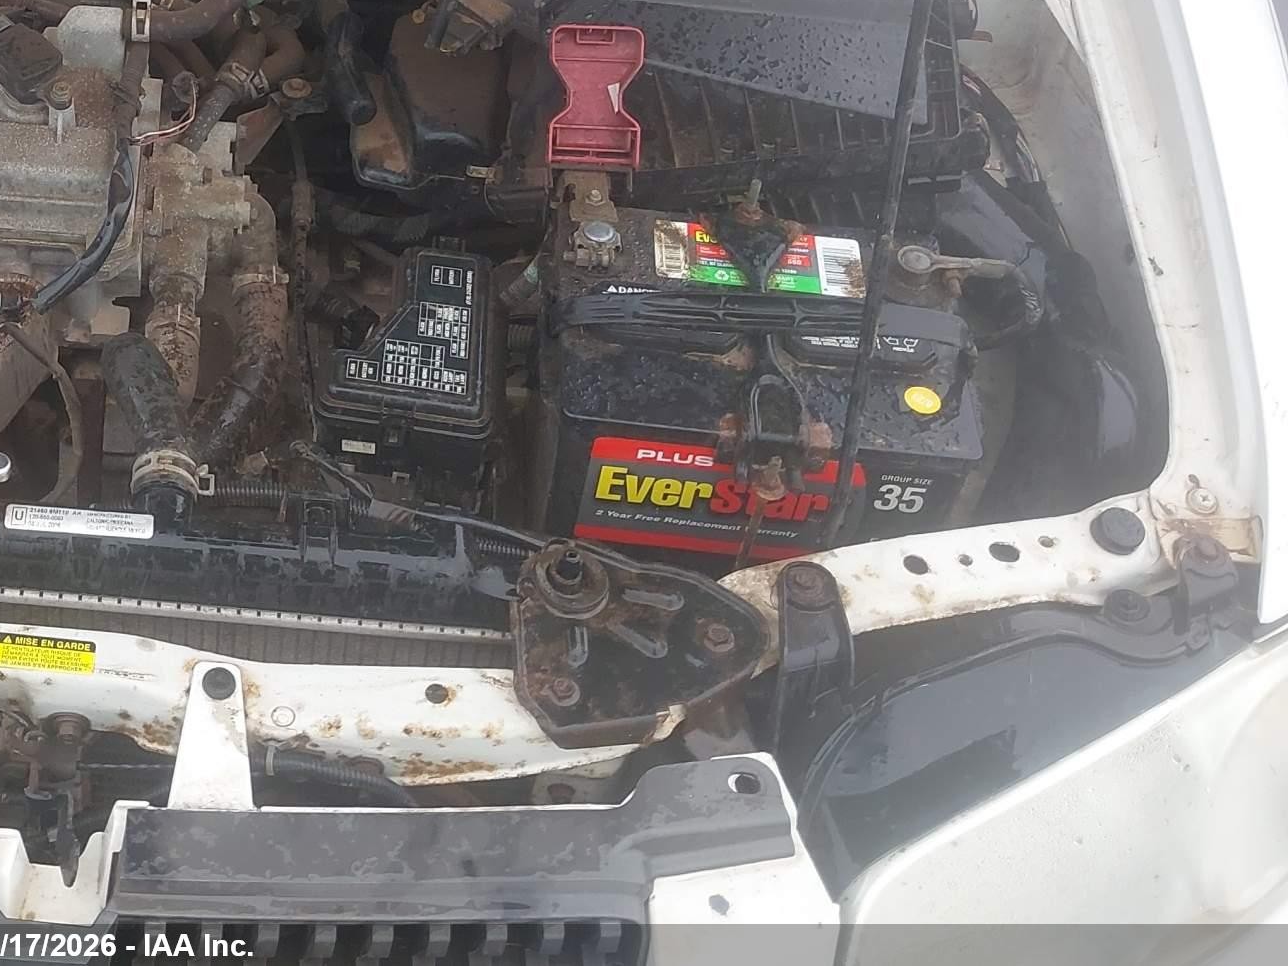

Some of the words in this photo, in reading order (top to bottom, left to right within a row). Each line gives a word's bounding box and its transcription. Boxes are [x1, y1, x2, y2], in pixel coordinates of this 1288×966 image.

[637, 449, 714, 467] PLUS
[881, 474, 912, 483] GROUP
[874, 484, 927, 513] 35
[15, 510, 24, 521] U
[605, 510, 632, 519] Year
[634, 513, 661, 522] Free
[663, 517, 740, 531] Replacement
[15, 637, 38, 646] MISE
[56, 641, 91, 651] GARDE
